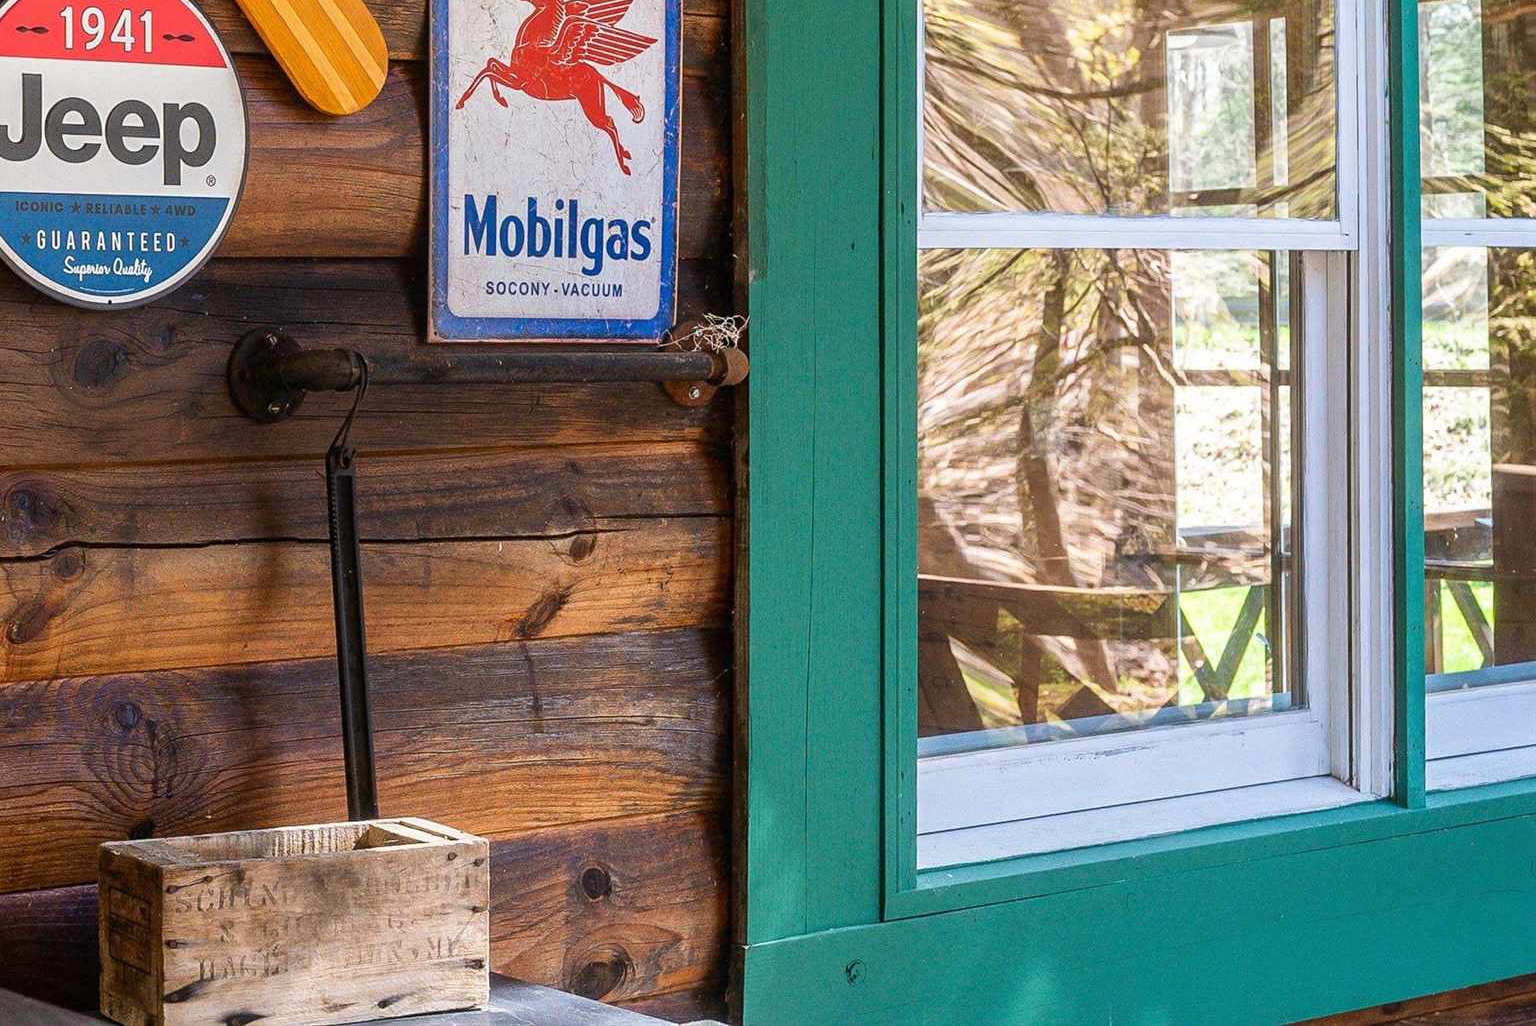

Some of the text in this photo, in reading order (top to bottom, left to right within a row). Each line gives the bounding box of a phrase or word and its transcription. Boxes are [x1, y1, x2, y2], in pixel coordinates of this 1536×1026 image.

[59, 5, 153, 54] 1941
[16, 201, 196, 216] ICONIC RELIABLE 4WD
[36, 229, 176, 252] GUARANTEED
[464, 193, 652, 277] Mobilgas
[64, 256, 152, 283] Superior Quality
